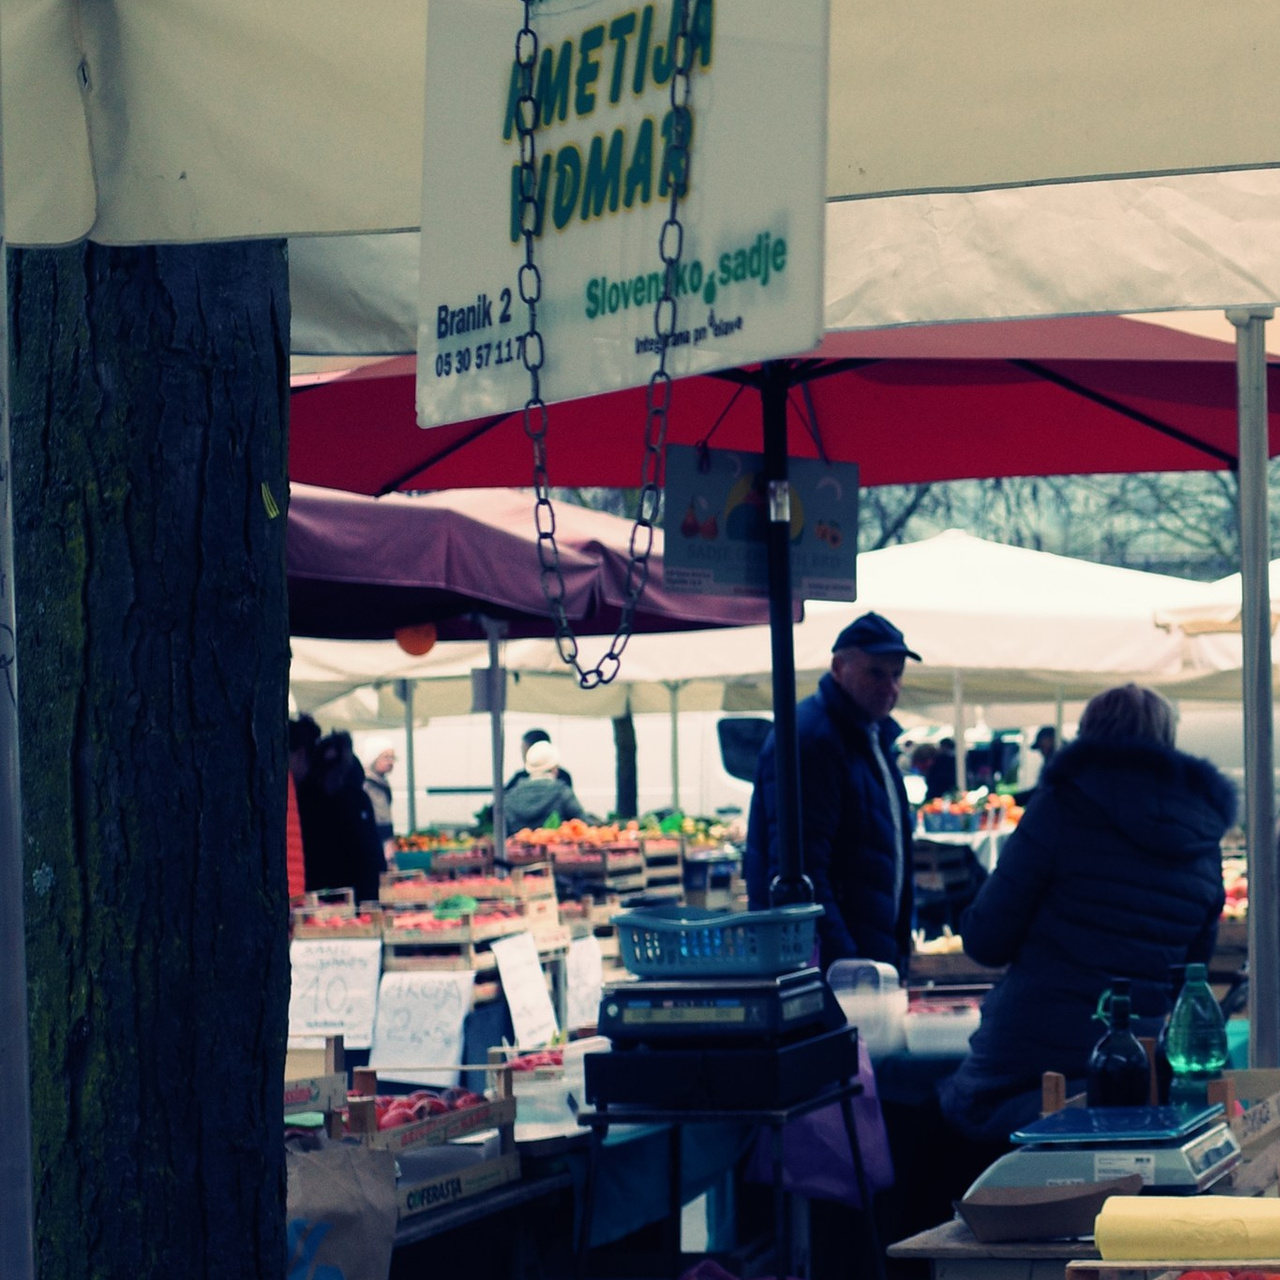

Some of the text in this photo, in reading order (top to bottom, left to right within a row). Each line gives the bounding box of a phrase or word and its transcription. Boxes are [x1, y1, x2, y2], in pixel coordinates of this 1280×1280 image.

[585, 231, 787, 319] Slovenko sadje
[437, 287, 511, 339] Branik 2
[435, 352, 451, 377] 05
